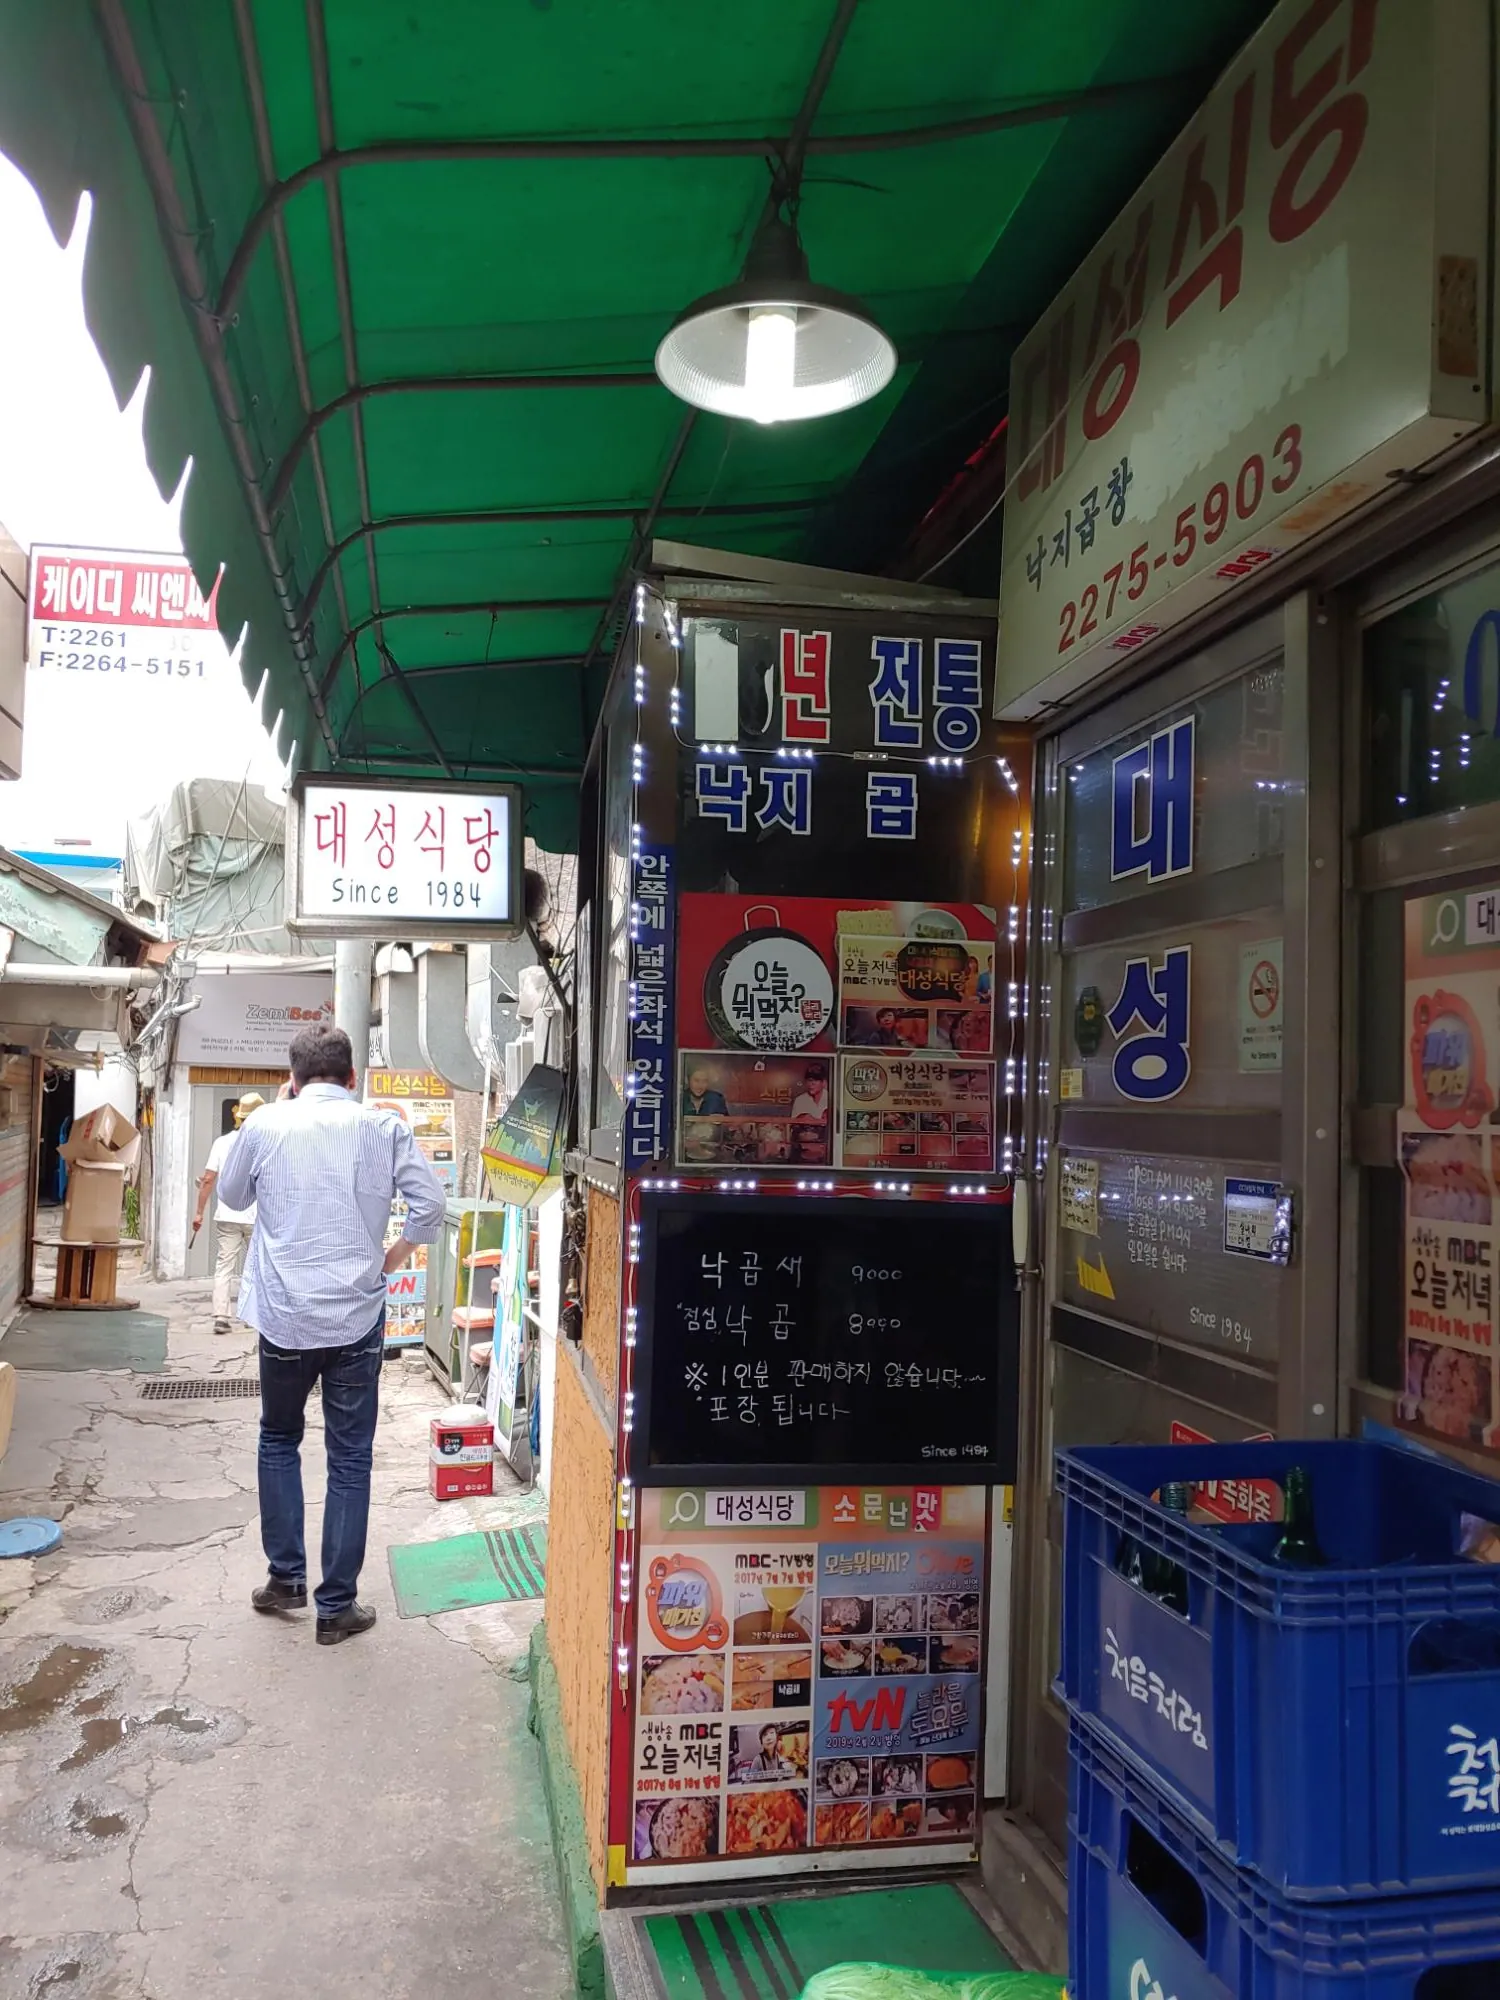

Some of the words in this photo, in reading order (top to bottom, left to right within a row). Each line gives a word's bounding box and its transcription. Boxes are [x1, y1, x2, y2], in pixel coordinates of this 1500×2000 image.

[1026, 456, 1134, 593] 낙지곱창
[1058, 422, 1304, 654] 2275-5903
[41, 565, 123, 616] 케이디
[41, 627, 127, 648] T:2261
[39, 651, 204, 677] F:2264-5151
[780, 628, 832, 744] 년
[869, 636, 982, 752] 전통
[696, 763, 812, 835] 낙지
[866, 771, 918, 840] 곱
[313, 801, 500, 875] 대성식당
[331, 879, 399, 905] Since
[426, 881, 482, 908] 1984
[636, 854, 670, 930] 안쪽에
[1477, 896, 1500, 935] 대
[752, 960, 789, 996] 오늘
[843, 958, 870, 974] 오늘
[871, 959, 898, 976] 저녁
[246, 1003, 323, 1021] ZemiBee
[373, 1073, 446, 1096] 대성식당
[889, 1062, 948, 1081] 대성식당
[631, 1058, 664, 1161] 있습니다
[1447, 1237, 1491, 1267] MBC
[388, 1275, 416, 1295] vN
[851, 1265, 902, 1284] 9000
[1411, 1260, 1448, 1310] 오늘
[1452, 1268, 1491, 1321] 저녁
[1190, 1306, 1216, 1329] Since
[1221, 1318, 1252, 1353] 1984
[787, 1359, 871, 1387] 판매하지
[921, 1445, 957, 1457] Since
[716, 1495, 795, 1522] 대성식당
[833, 1493, 908, 1527] 소문난
[1105, 1627, 1208, 1751] 처음처럼
[826, 1685, 907, 1733] tvN
[641, 1721, 673, 1741] 생방송
[680, 1722, 722, 1741] MBC
[640, 1744, 680, 1774] 오늘
[683, 1743, 722, 1772] 저녁
[1446, 1724, 1500, 1774] 처
[1448, 1774, 1500, 1814] 처
